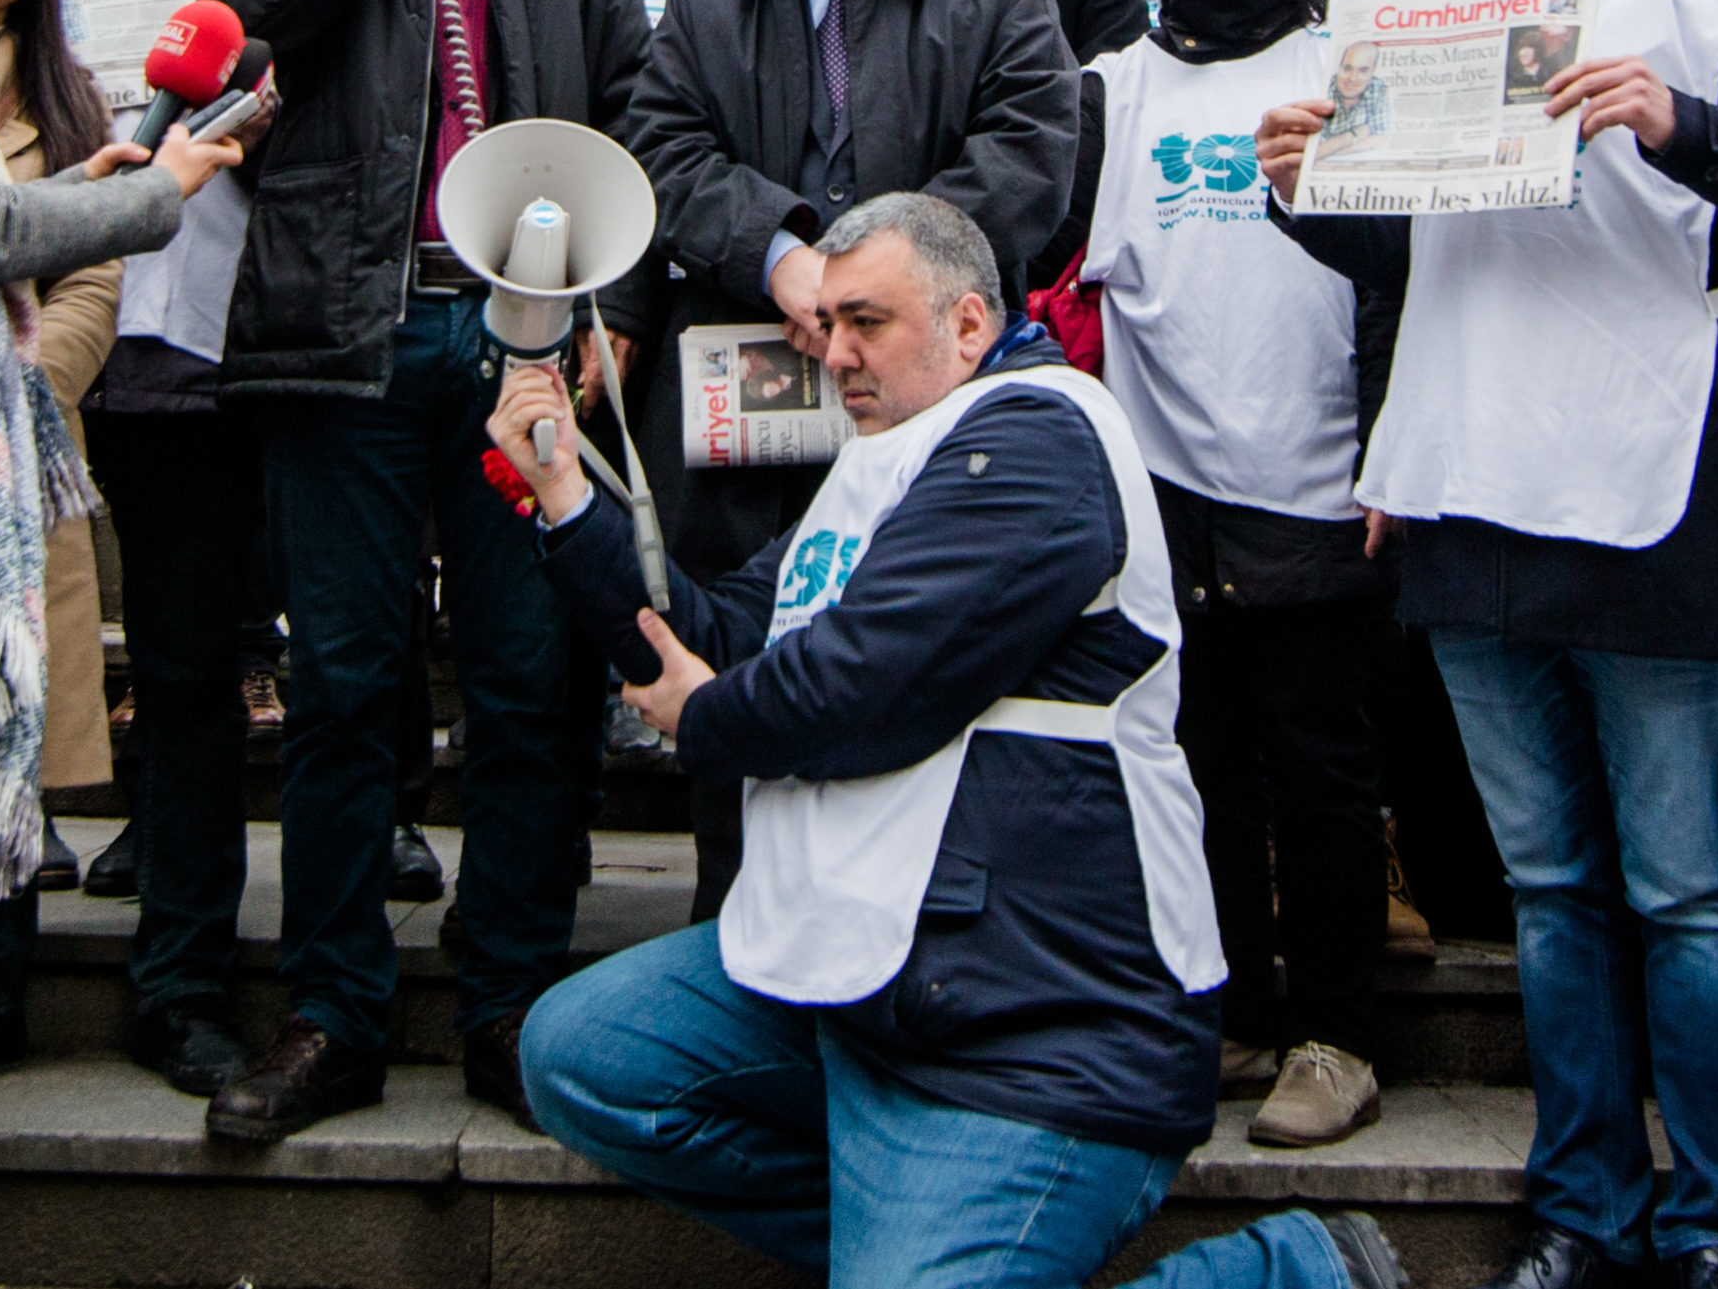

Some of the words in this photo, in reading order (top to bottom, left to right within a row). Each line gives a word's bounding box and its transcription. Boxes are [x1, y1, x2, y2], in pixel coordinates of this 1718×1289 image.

[1382, 50, 1437, 69] Herkes
[1441, 44, 1500, 64] Mumcu
[1412, 67, 1452, 87] olsun
[1151, 133, 1258, 193] tg
[1308, 185, 1422, 212] Vekilime
